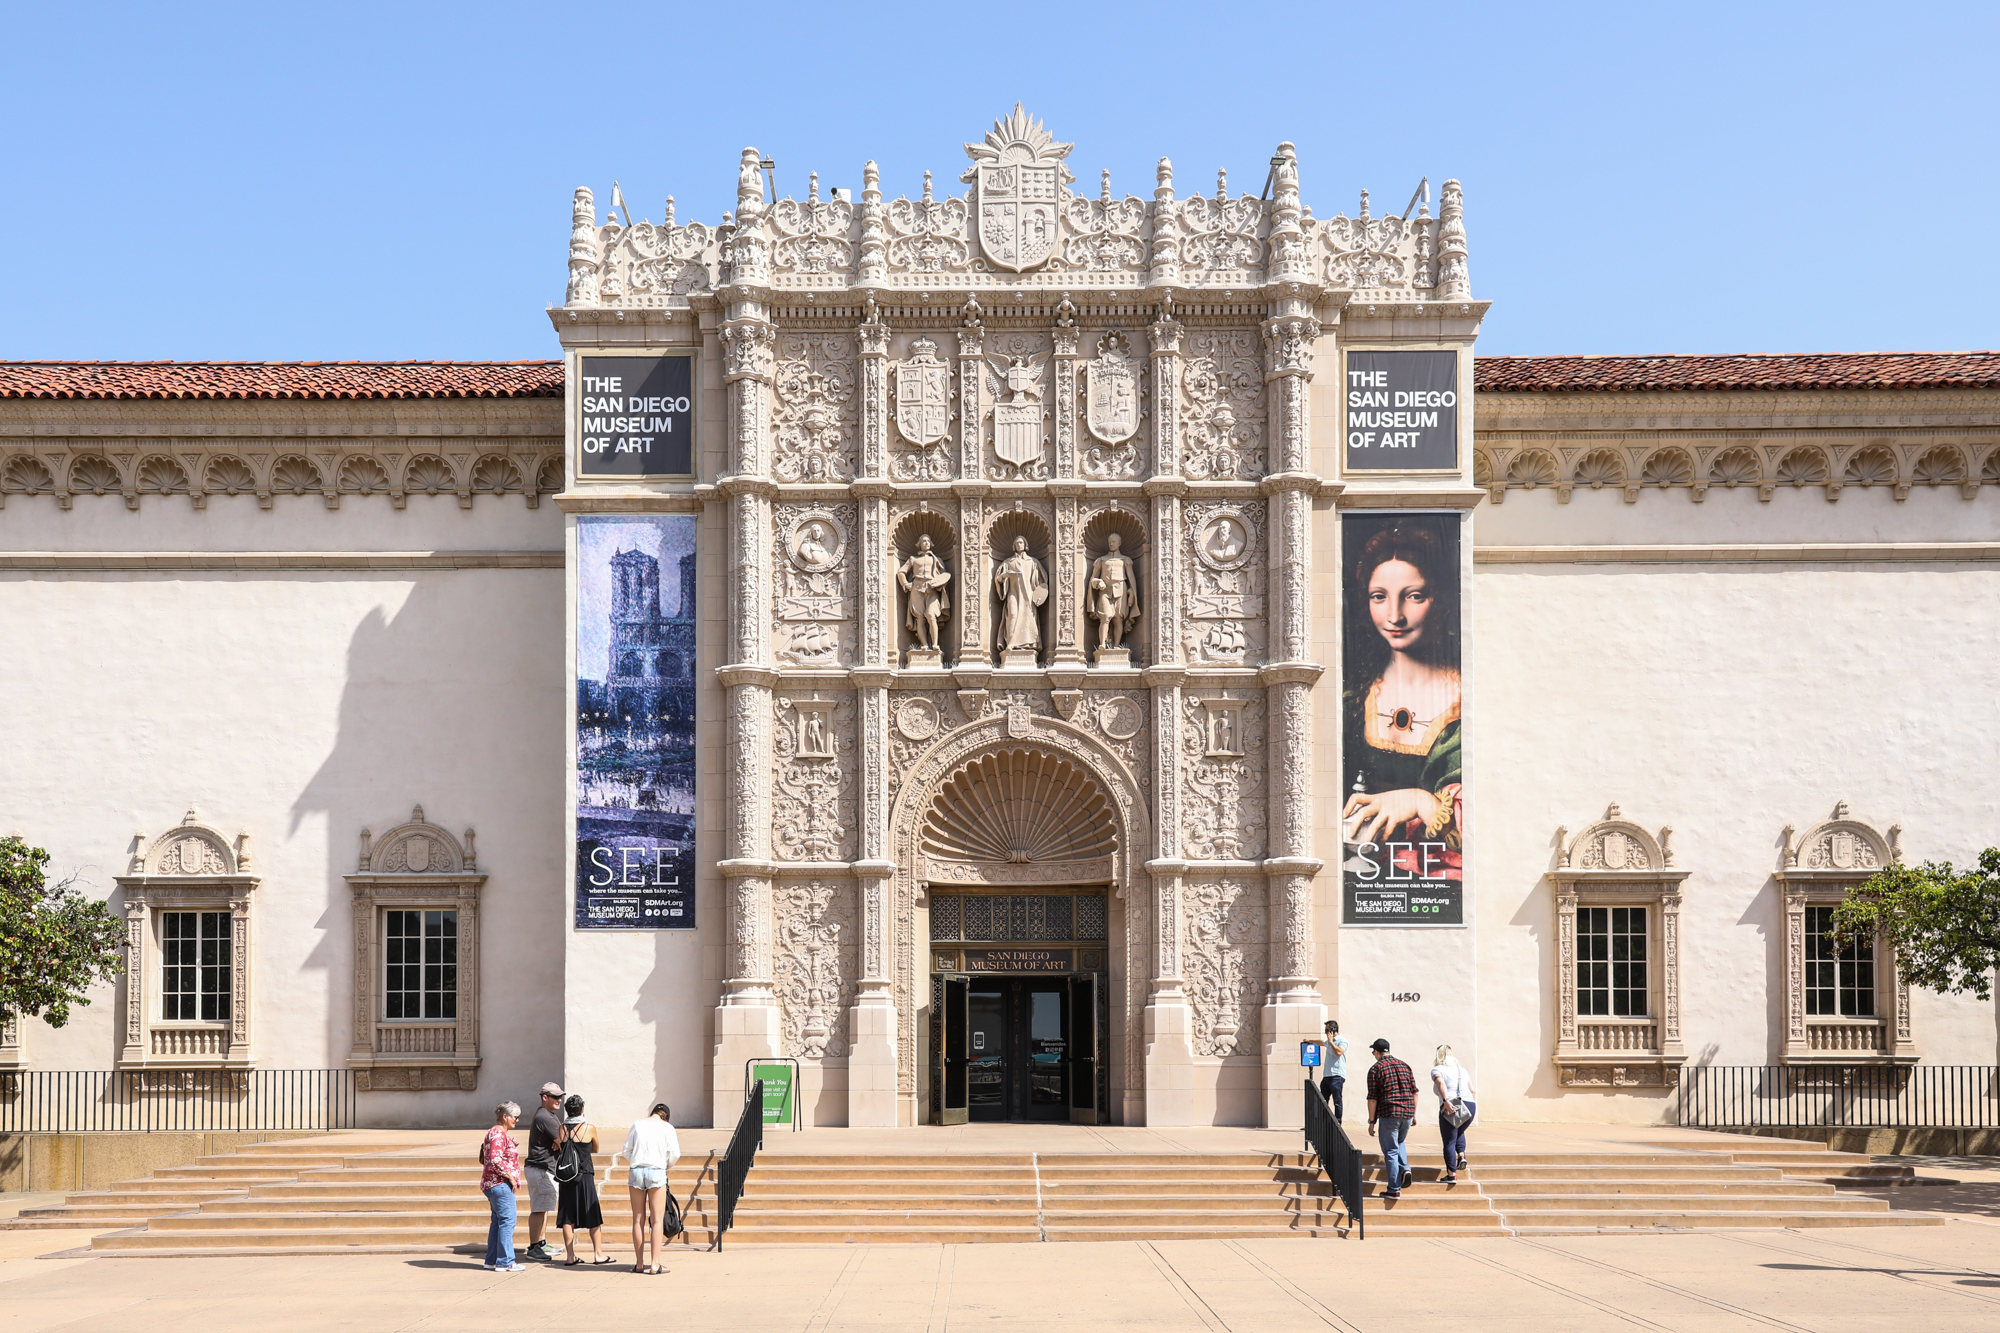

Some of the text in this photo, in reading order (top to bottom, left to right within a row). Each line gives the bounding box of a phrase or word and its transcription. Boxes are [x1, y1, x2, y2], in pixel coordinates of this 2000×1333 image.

[583, 377, 622, 392] THE
[1349, 371, 1387, 387] THE
[583, 397, 690, 413] SAN DIEGO
[1349, 391, 1456, 407] SAN DIEGO
[584, 417, 671, 433] MUSEUM
[1349, 412, 1437, 428] MUSEUM
[583, 438, 654, 453] OF ART
[1349, 432, 1420, 448] OF ART
[589, 847, 679, 886] SEE
[1356, 842, 1447, 881] SEE
[987, 952, 1050, 960] SAN DIEGO
[971, 961, 1066, 970] MUSEUM OF ART
[1390, 992, 1421, 1002] 1450
